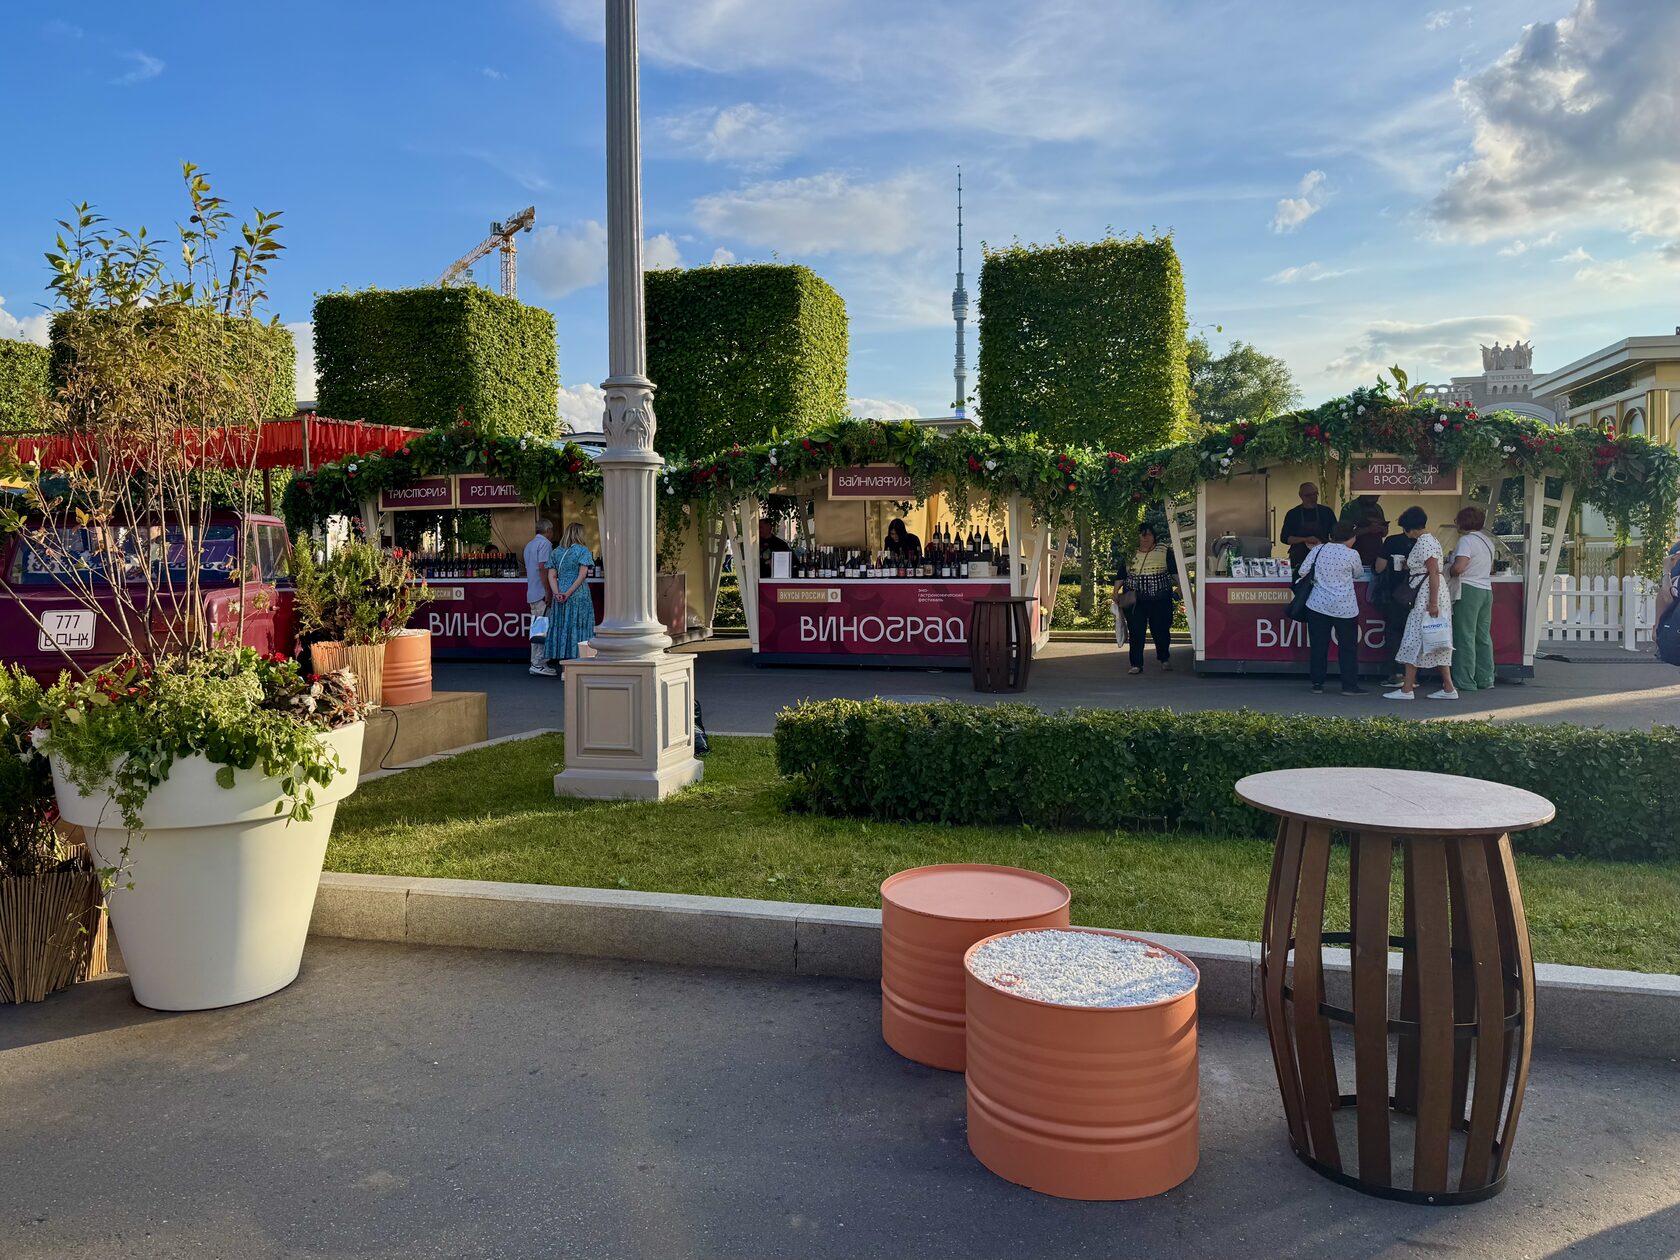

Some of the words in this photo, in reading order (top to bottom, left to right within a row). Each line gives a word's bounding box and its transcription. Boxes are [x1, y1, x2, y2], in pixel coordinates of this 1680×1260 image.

[1368, 464, 1440, 475] ИТАЛЬЦЫ
[839, 474, 911, 487] ВАЙНМАФИЯ
[1373, 475, 1381, 485] В
[1382, 475, 1433, 485] РОССИ
[779, 591, 800, 600] ВКУСЫ
[801, 591, 826, 600] РОССИИ
[1231, 591, 1257, 600] ВКУСЫ
[1258, 591, 1289, 600] РОССИИ
[56, 614, 81, 629] 777
[800, 615, 968, 643] ВИНОГРАД
